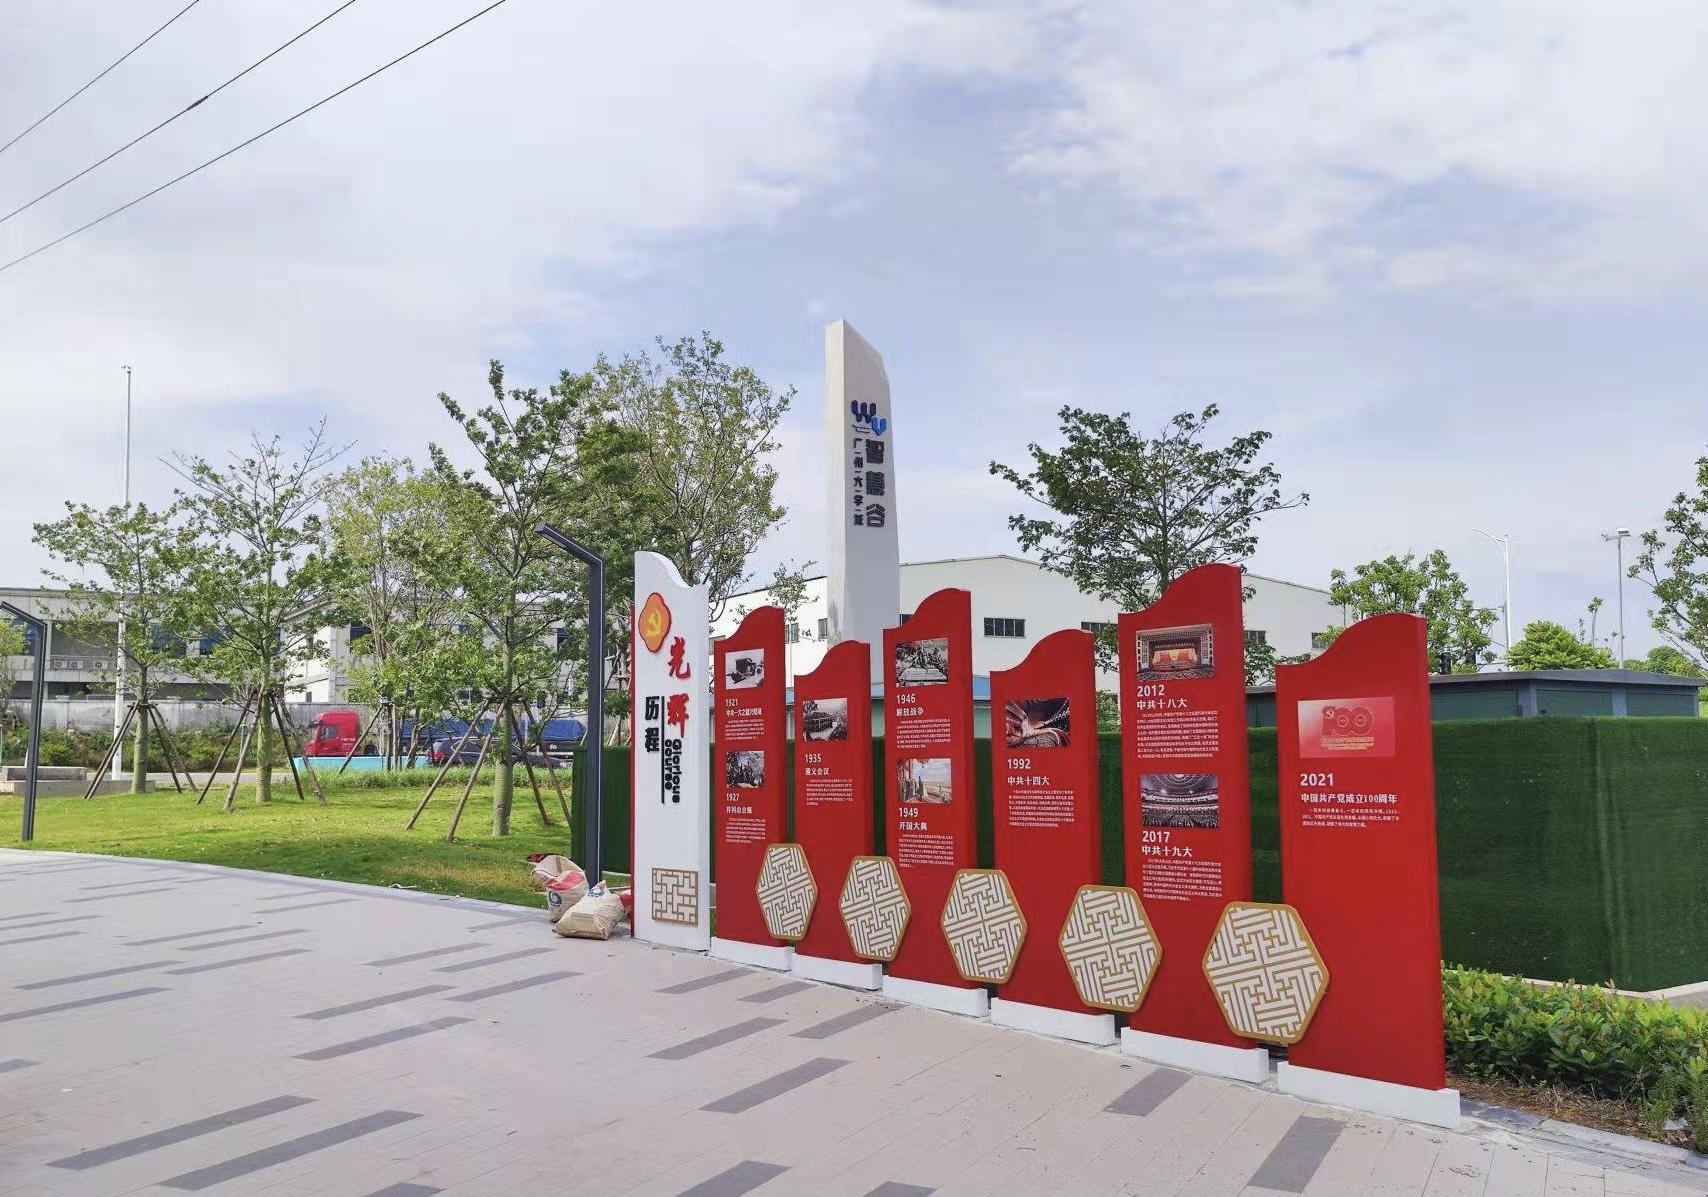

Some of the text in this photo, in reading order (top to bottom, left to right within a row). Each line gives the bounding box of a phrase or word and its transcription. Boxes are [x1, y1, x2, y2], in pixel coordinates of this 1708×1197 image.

[1137, 684, 1165, 697] 2012
[1136, 698, 1187, 710] 中共十八大
[644, 696, 660, 753] 历程
[804, 753, 822, 763] 1935
[1007, 758, 1031, 770] 1992
[804, 767, 830, 776] 遵义会议
[1007, 775, 1050, 786] 中共十四大
[1300, 772, 1334, 787] 2021
[726, 792, 740, 801] 1927
[1301, 793, 1397, 804] 中国共产党成立100周年
[899, 807, 919, 818] 1949
[899, 821, 928, 831] 开国大典
[1142, 830, 1171, 843] 2017
[1141, 845, 1193, 858] 中共十九大
